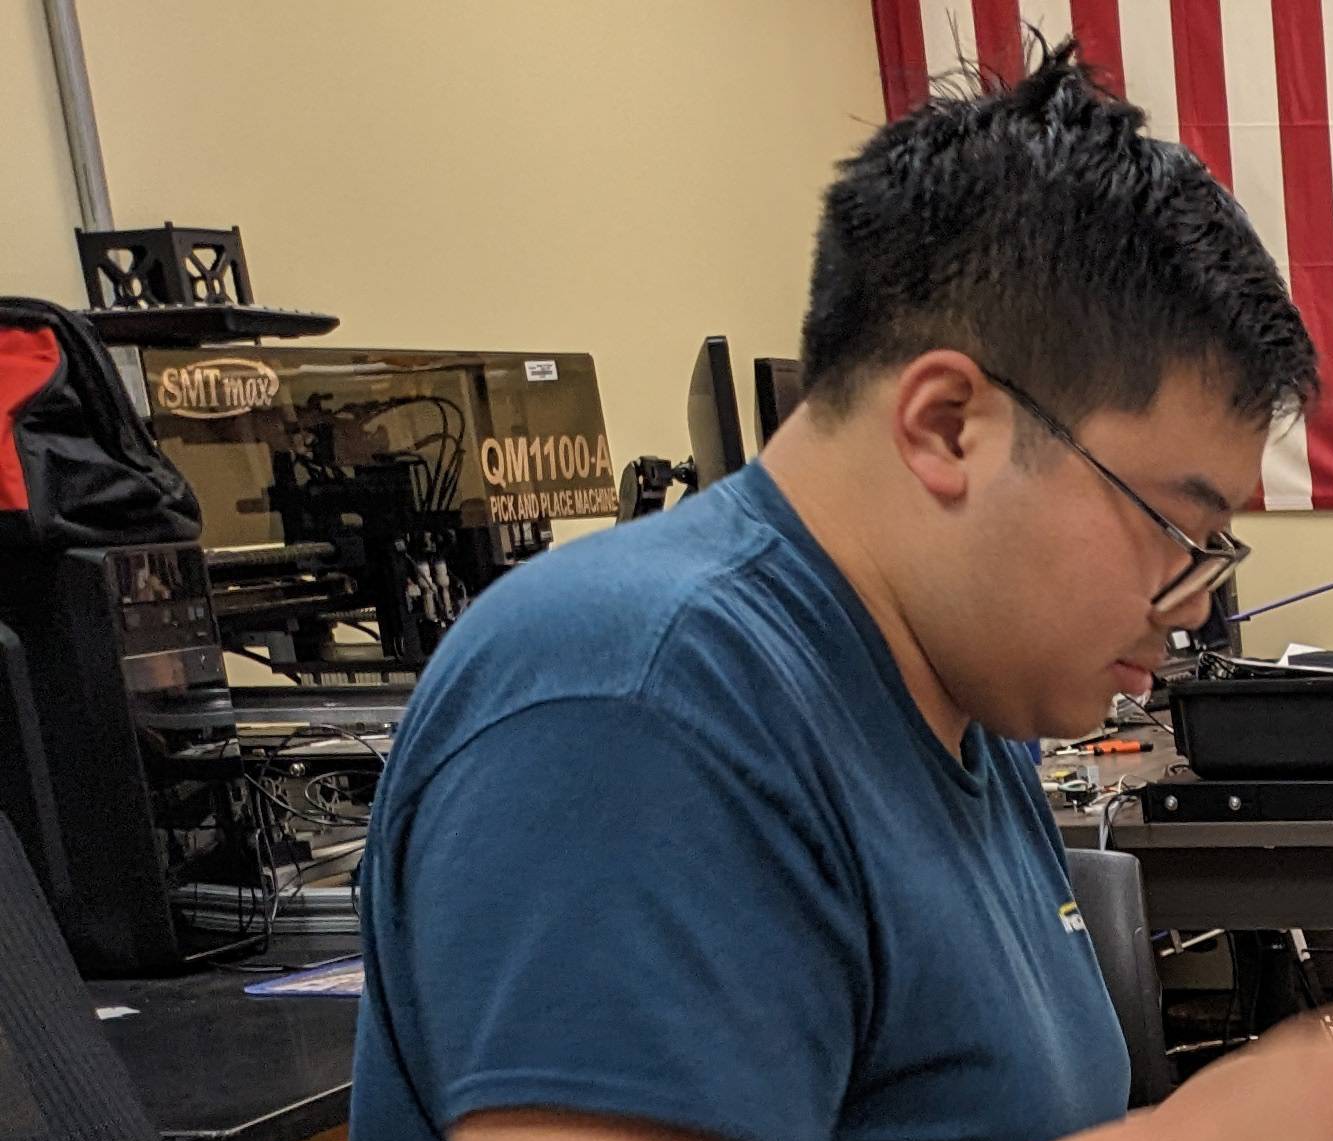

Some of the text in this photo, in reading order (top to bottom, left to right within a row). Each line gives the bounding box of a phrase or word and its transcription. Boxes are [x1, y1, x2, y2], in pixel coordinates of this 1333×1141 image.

[158, 368, 222, 408] SMT
[481, 434, 613, 487] QM1100-A
[490, 486, 620, 523] PICK AND PLACE MACHINE
